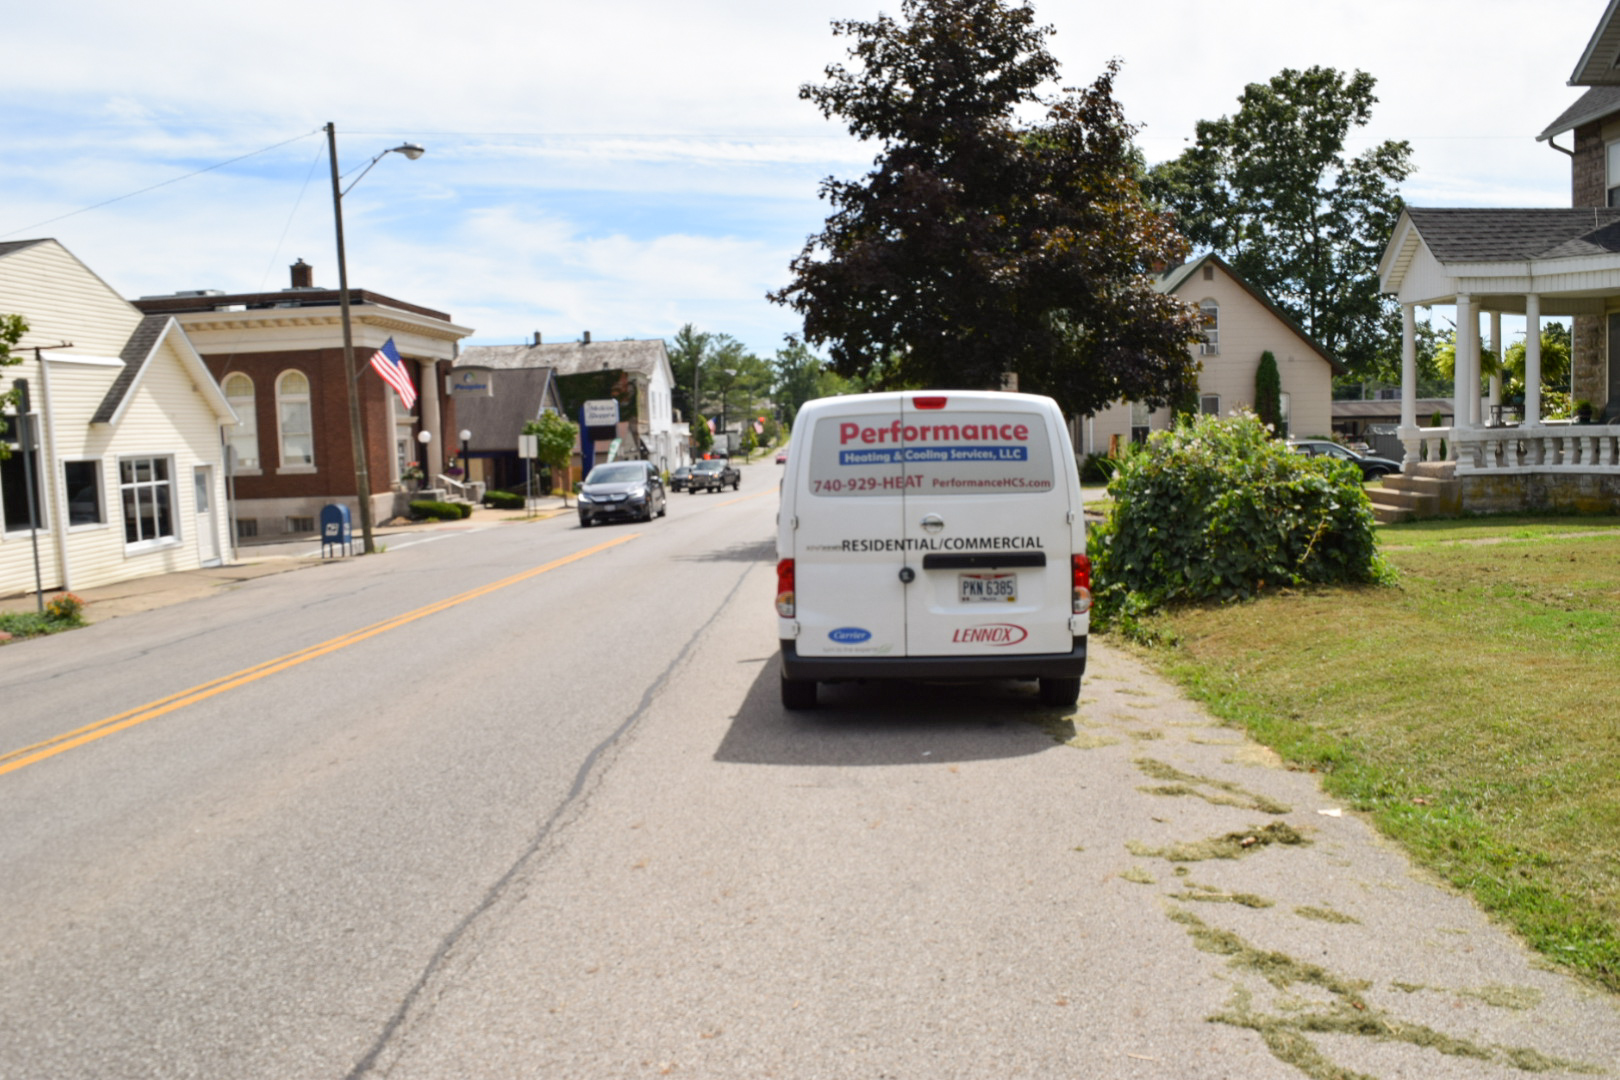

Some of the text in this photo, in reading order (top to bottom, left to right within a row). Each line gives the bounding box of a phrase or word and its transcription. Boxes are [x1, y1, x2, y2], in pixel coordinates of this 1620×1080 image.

[840, 420, 1029, 445] Performance
[844, 448, 1022, 464] Heating & Cooling Services, LLC
[813, 474, 924, 493] 740-929-HEAT
[932, 477, 1051, 489] PerformanceHCS.com
[842, 536, 1044, 552] RESIDENTIAL/COMMERCIAL
[962, 580, 1014, 596] PKN 6385
[833, 629, 867, 640] Carrier
[952, 627, 1013, 643] LENNOX
